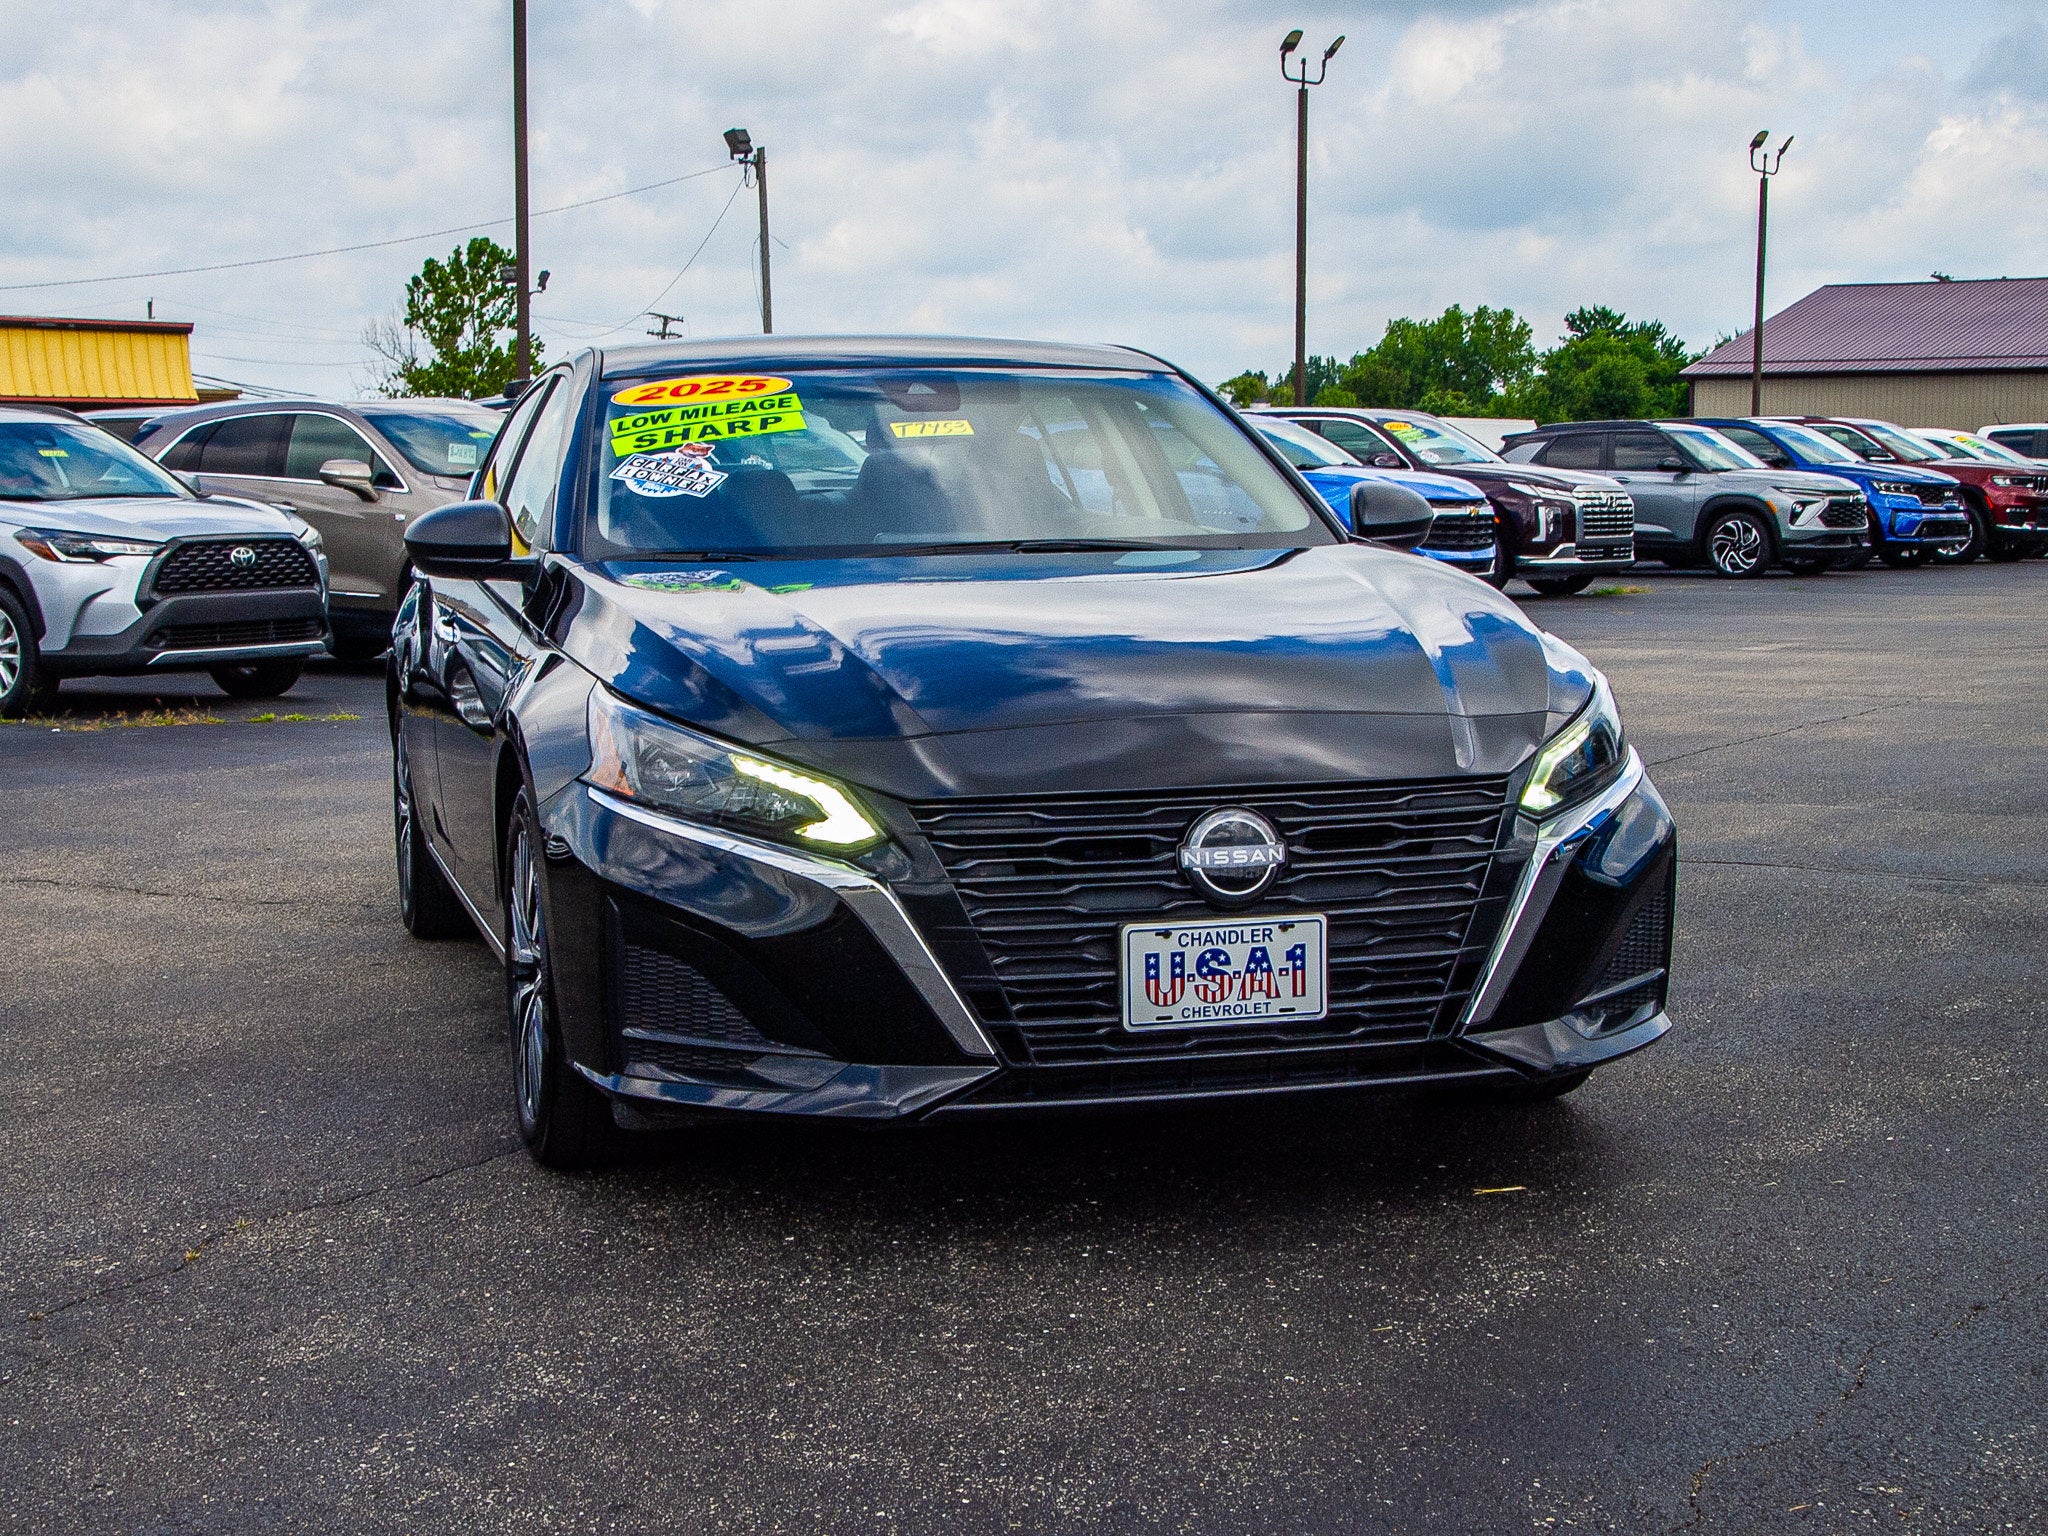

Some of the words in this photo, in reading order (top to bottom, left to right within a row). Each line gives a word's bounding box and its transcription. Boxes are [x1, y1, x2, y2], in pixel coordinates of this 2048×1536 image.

[632, 378, 771, 403] 2025
[616, 412, 672, 433] LOW
[679, 396, 793, 421] MILEAGE
[633, 415, 783, 449] SHARP
[632, 458, 714, 483] CARFAX
[1183, 847, 1284, 866] NISSAN
[1177, 927, 1274, 947] CHANDLER
[1181, 1001, 1272, 1019] CHEVROLET
